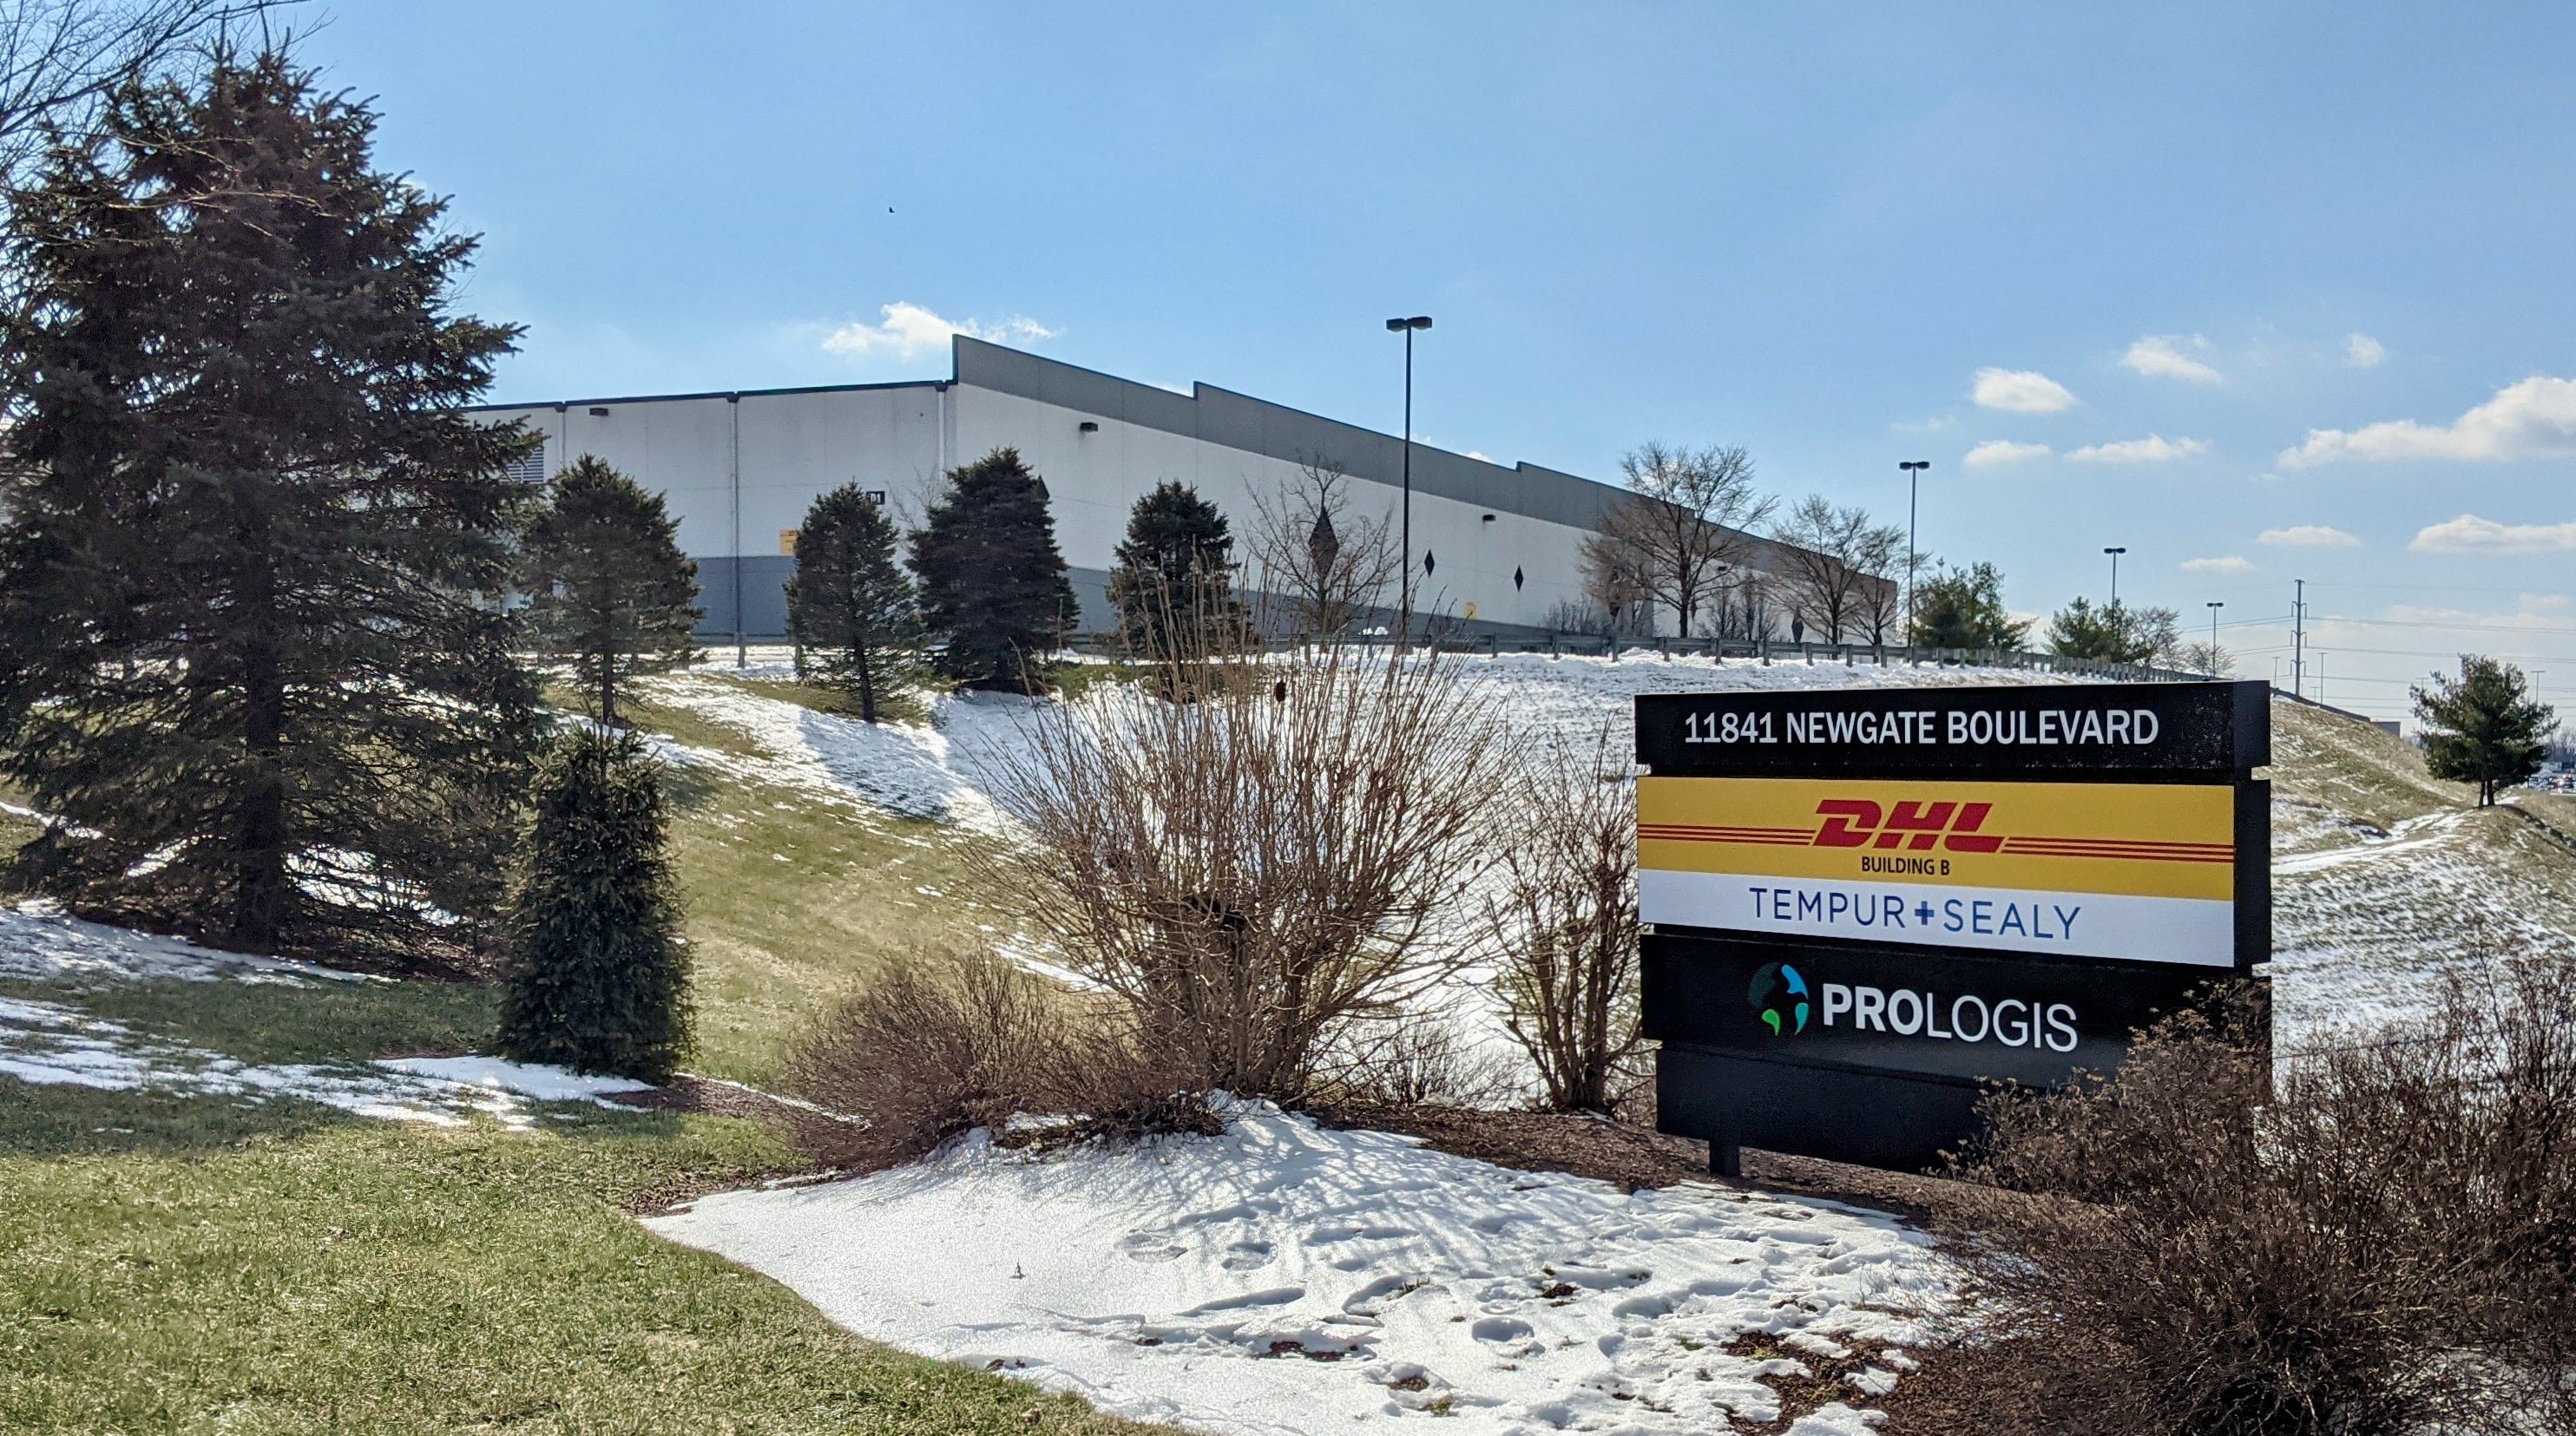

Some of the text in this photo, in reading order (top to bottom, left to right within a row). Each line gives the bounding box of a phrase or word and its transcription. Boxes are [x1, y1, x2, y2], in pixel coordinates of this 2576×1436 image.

[1685, 709, 2159, 744] 11841 NEWGATE BOULEVARD
[1811, 799, 2005, 853] DHL
[1861, 856, 1950, 875] BUILDING B
[1823, 982, 2078, 1052] PROLOGIS
